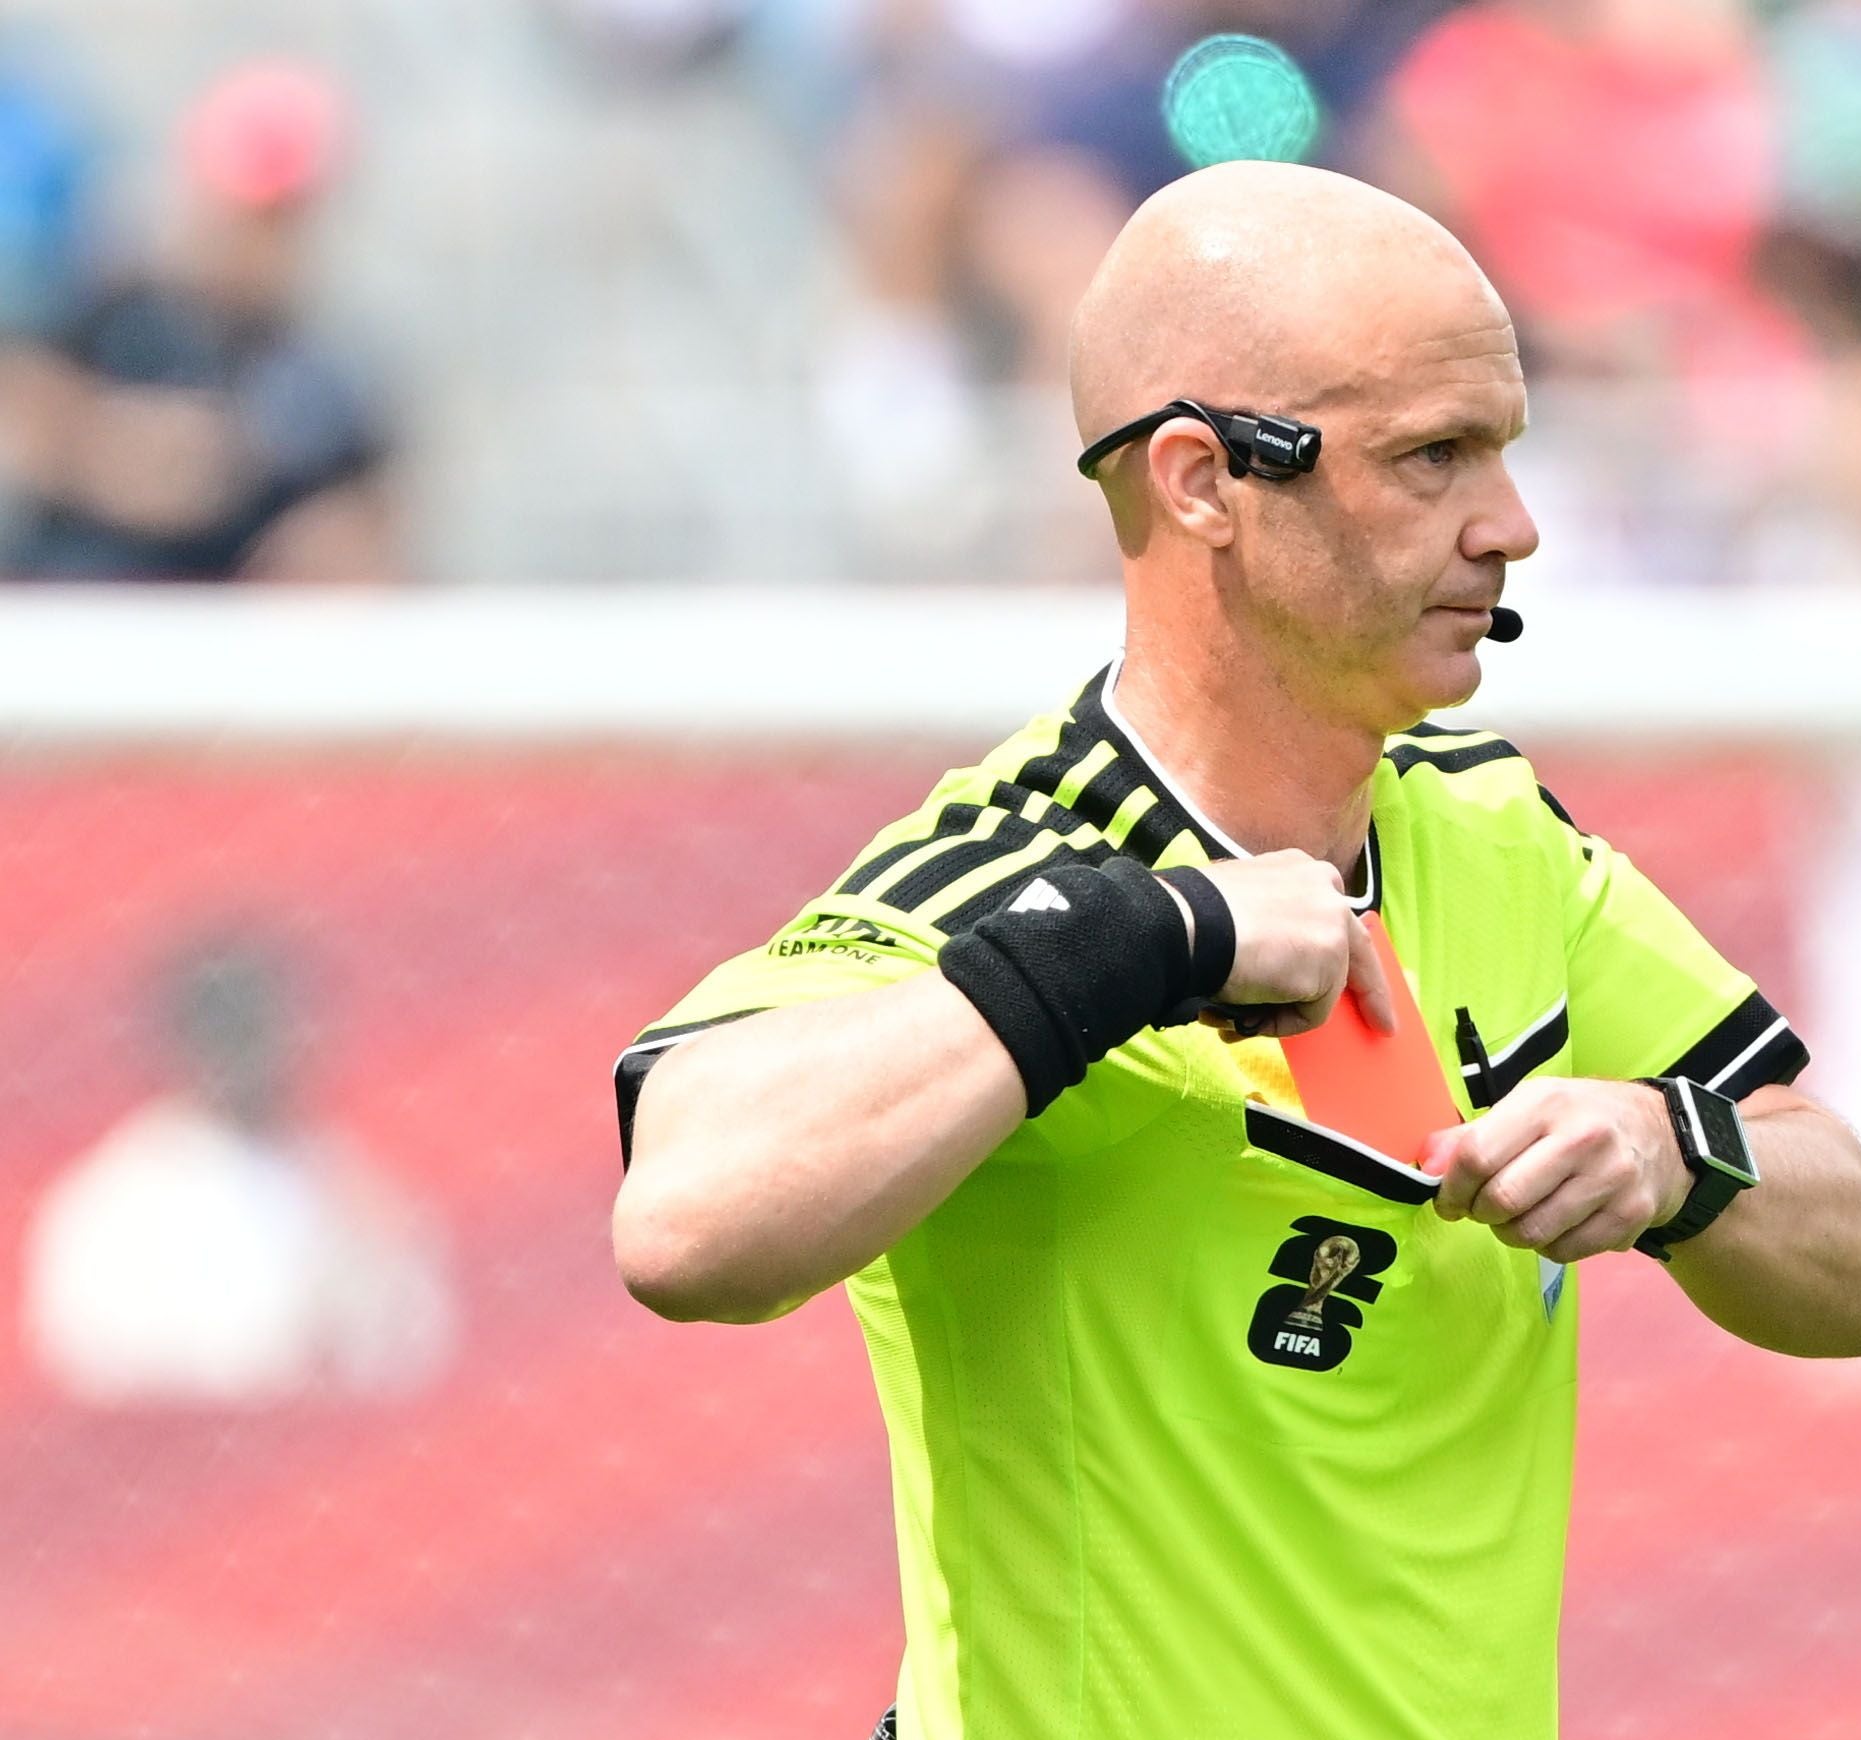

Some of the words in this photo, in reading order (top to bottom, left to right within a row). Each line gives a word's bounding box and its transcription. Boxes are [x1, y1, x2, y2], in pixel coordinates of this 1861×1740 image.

[1256, 428, 1293, 450] Lenovo
[831, 945, 881, 964] ONE
[1274, 1331, 1321, 1357] FIFA
